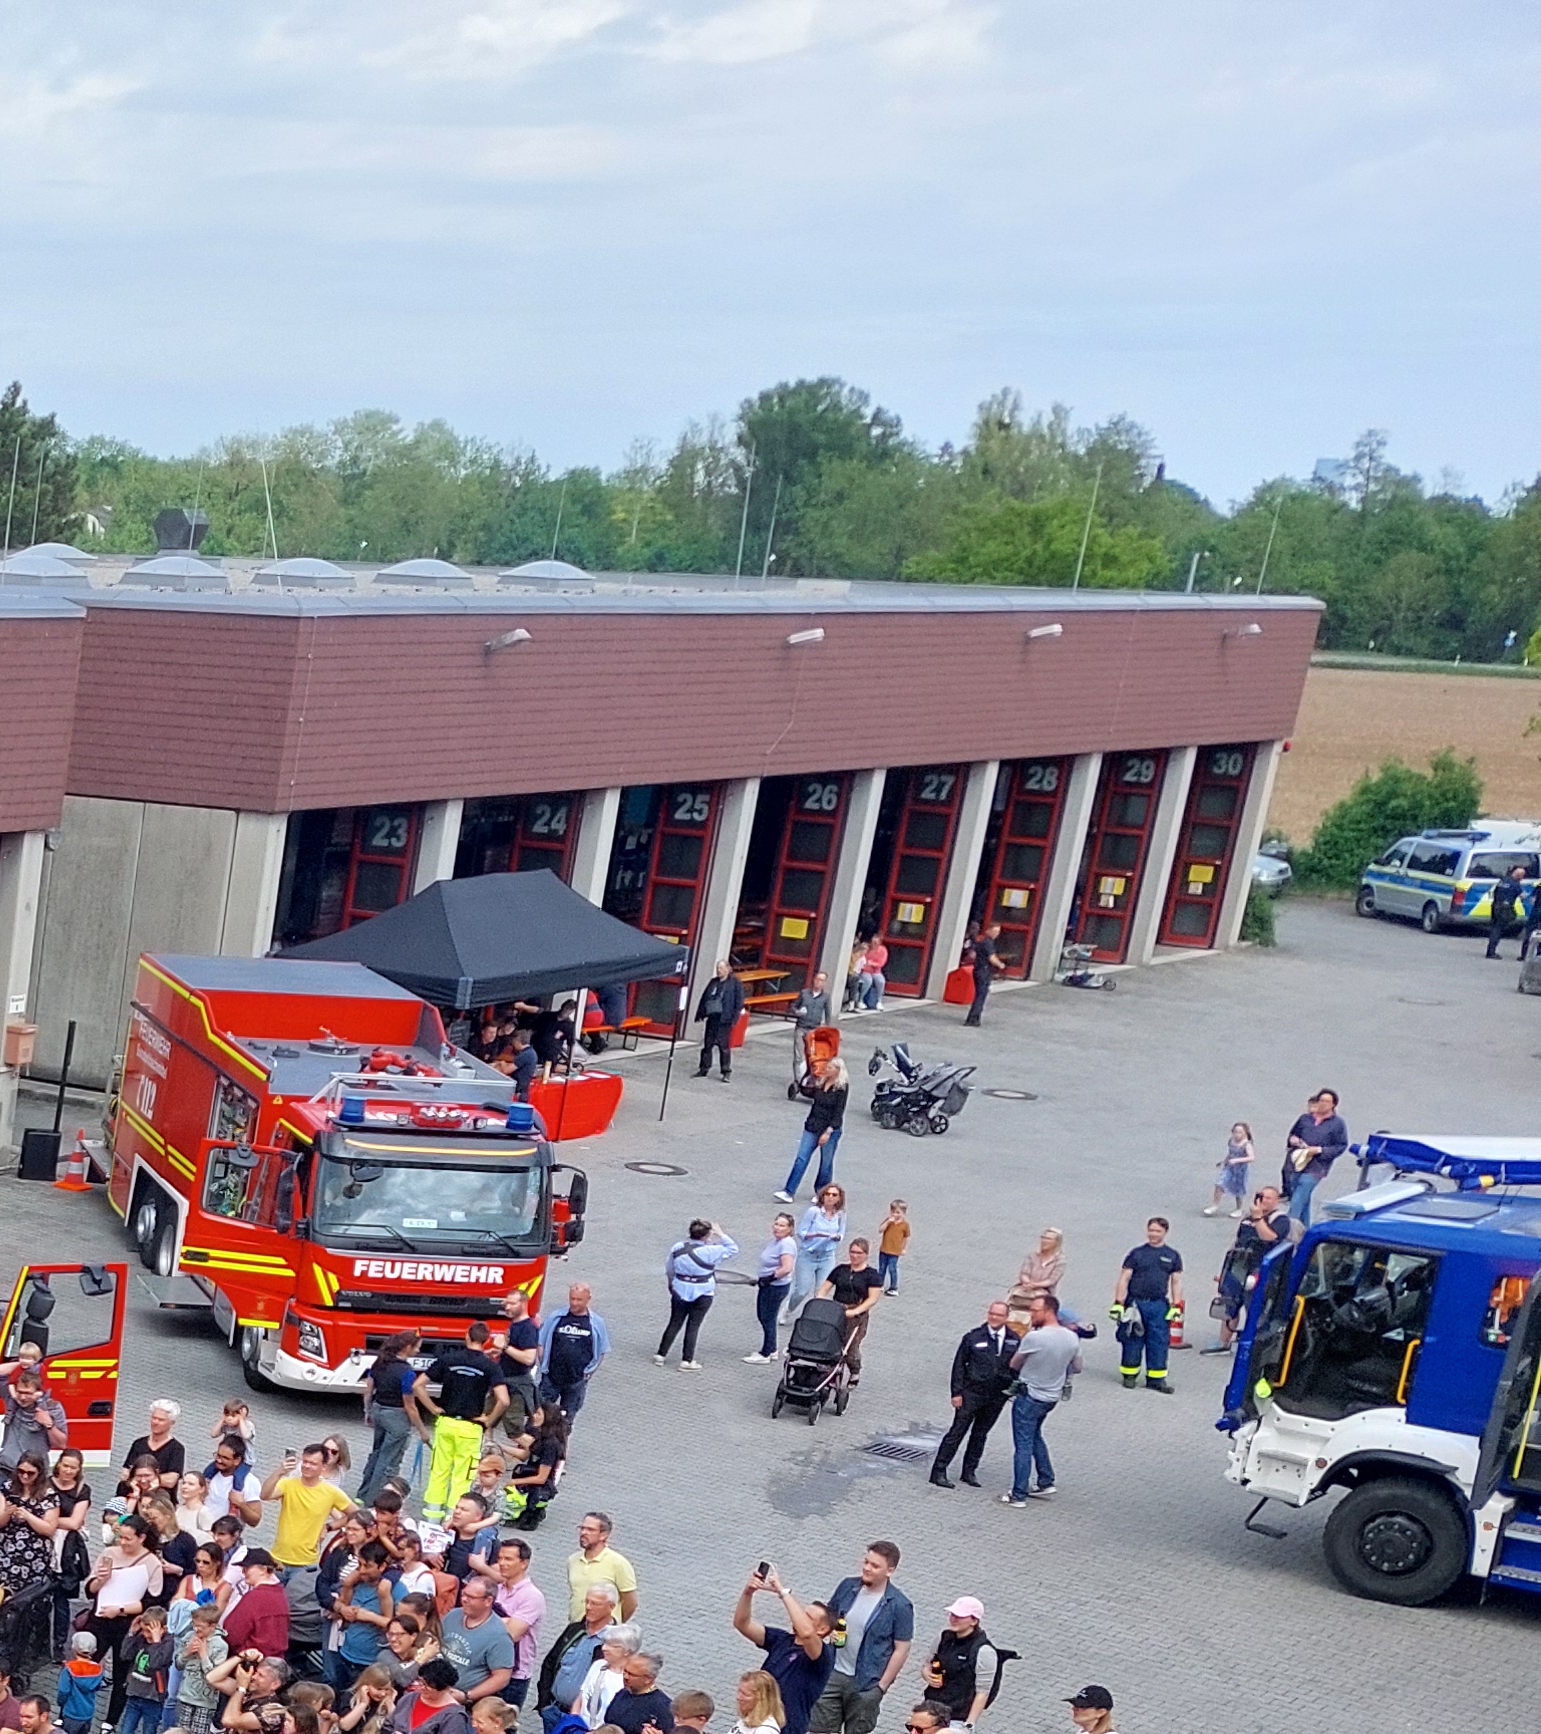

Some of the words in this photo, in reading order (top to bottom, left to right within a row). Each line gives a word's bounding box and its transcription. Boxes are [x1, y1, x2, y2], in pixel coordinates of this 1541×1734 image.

[1122, 757, 1156, 784] 29
[1212, 752, 1243, 775] 30
[920, 774, 956, 801] 27
[1025, 765, 1059, 791] 28
[674, 791, 710, 822] 25
[803, 783, 839, 811] 26
[371, 814, 408, 849] 23
[532, 803, 567, 836] 24
[353, 1259, 505, 1285] FEUERWEHR
